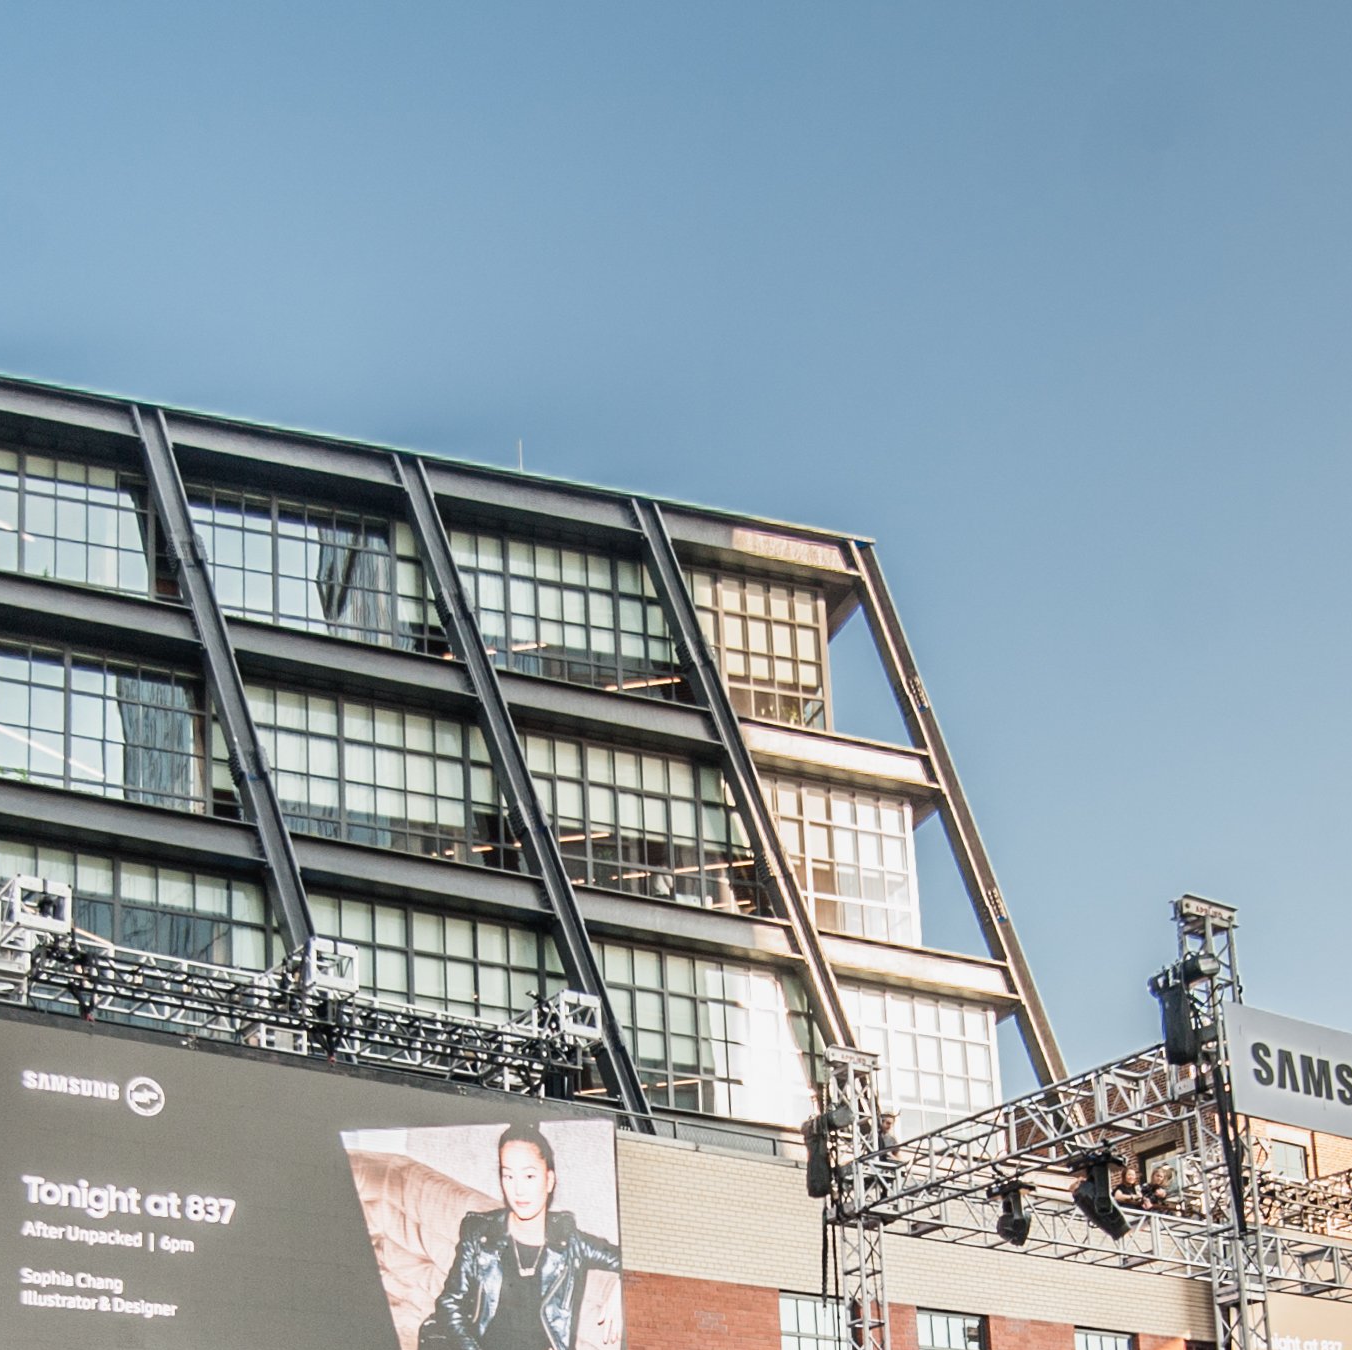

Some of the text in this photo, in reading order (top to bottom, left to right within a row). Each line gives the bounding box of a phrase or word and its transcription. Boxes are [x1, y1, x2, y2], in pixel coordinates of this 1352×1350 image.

[22, 1069, 120, 1101] SAMSUNG
[21, 1174, 236, 1225] Tonight at 837
[21, 1220, 65, 1240] After
[65, 1225, 143, 1248] Unpacked
[159, 1235, 195, 1253] 6pm
[19, 1267, 124, 1294] Sophia Chang
[19, 1290, 179, 1318] Illustrator & Designer
